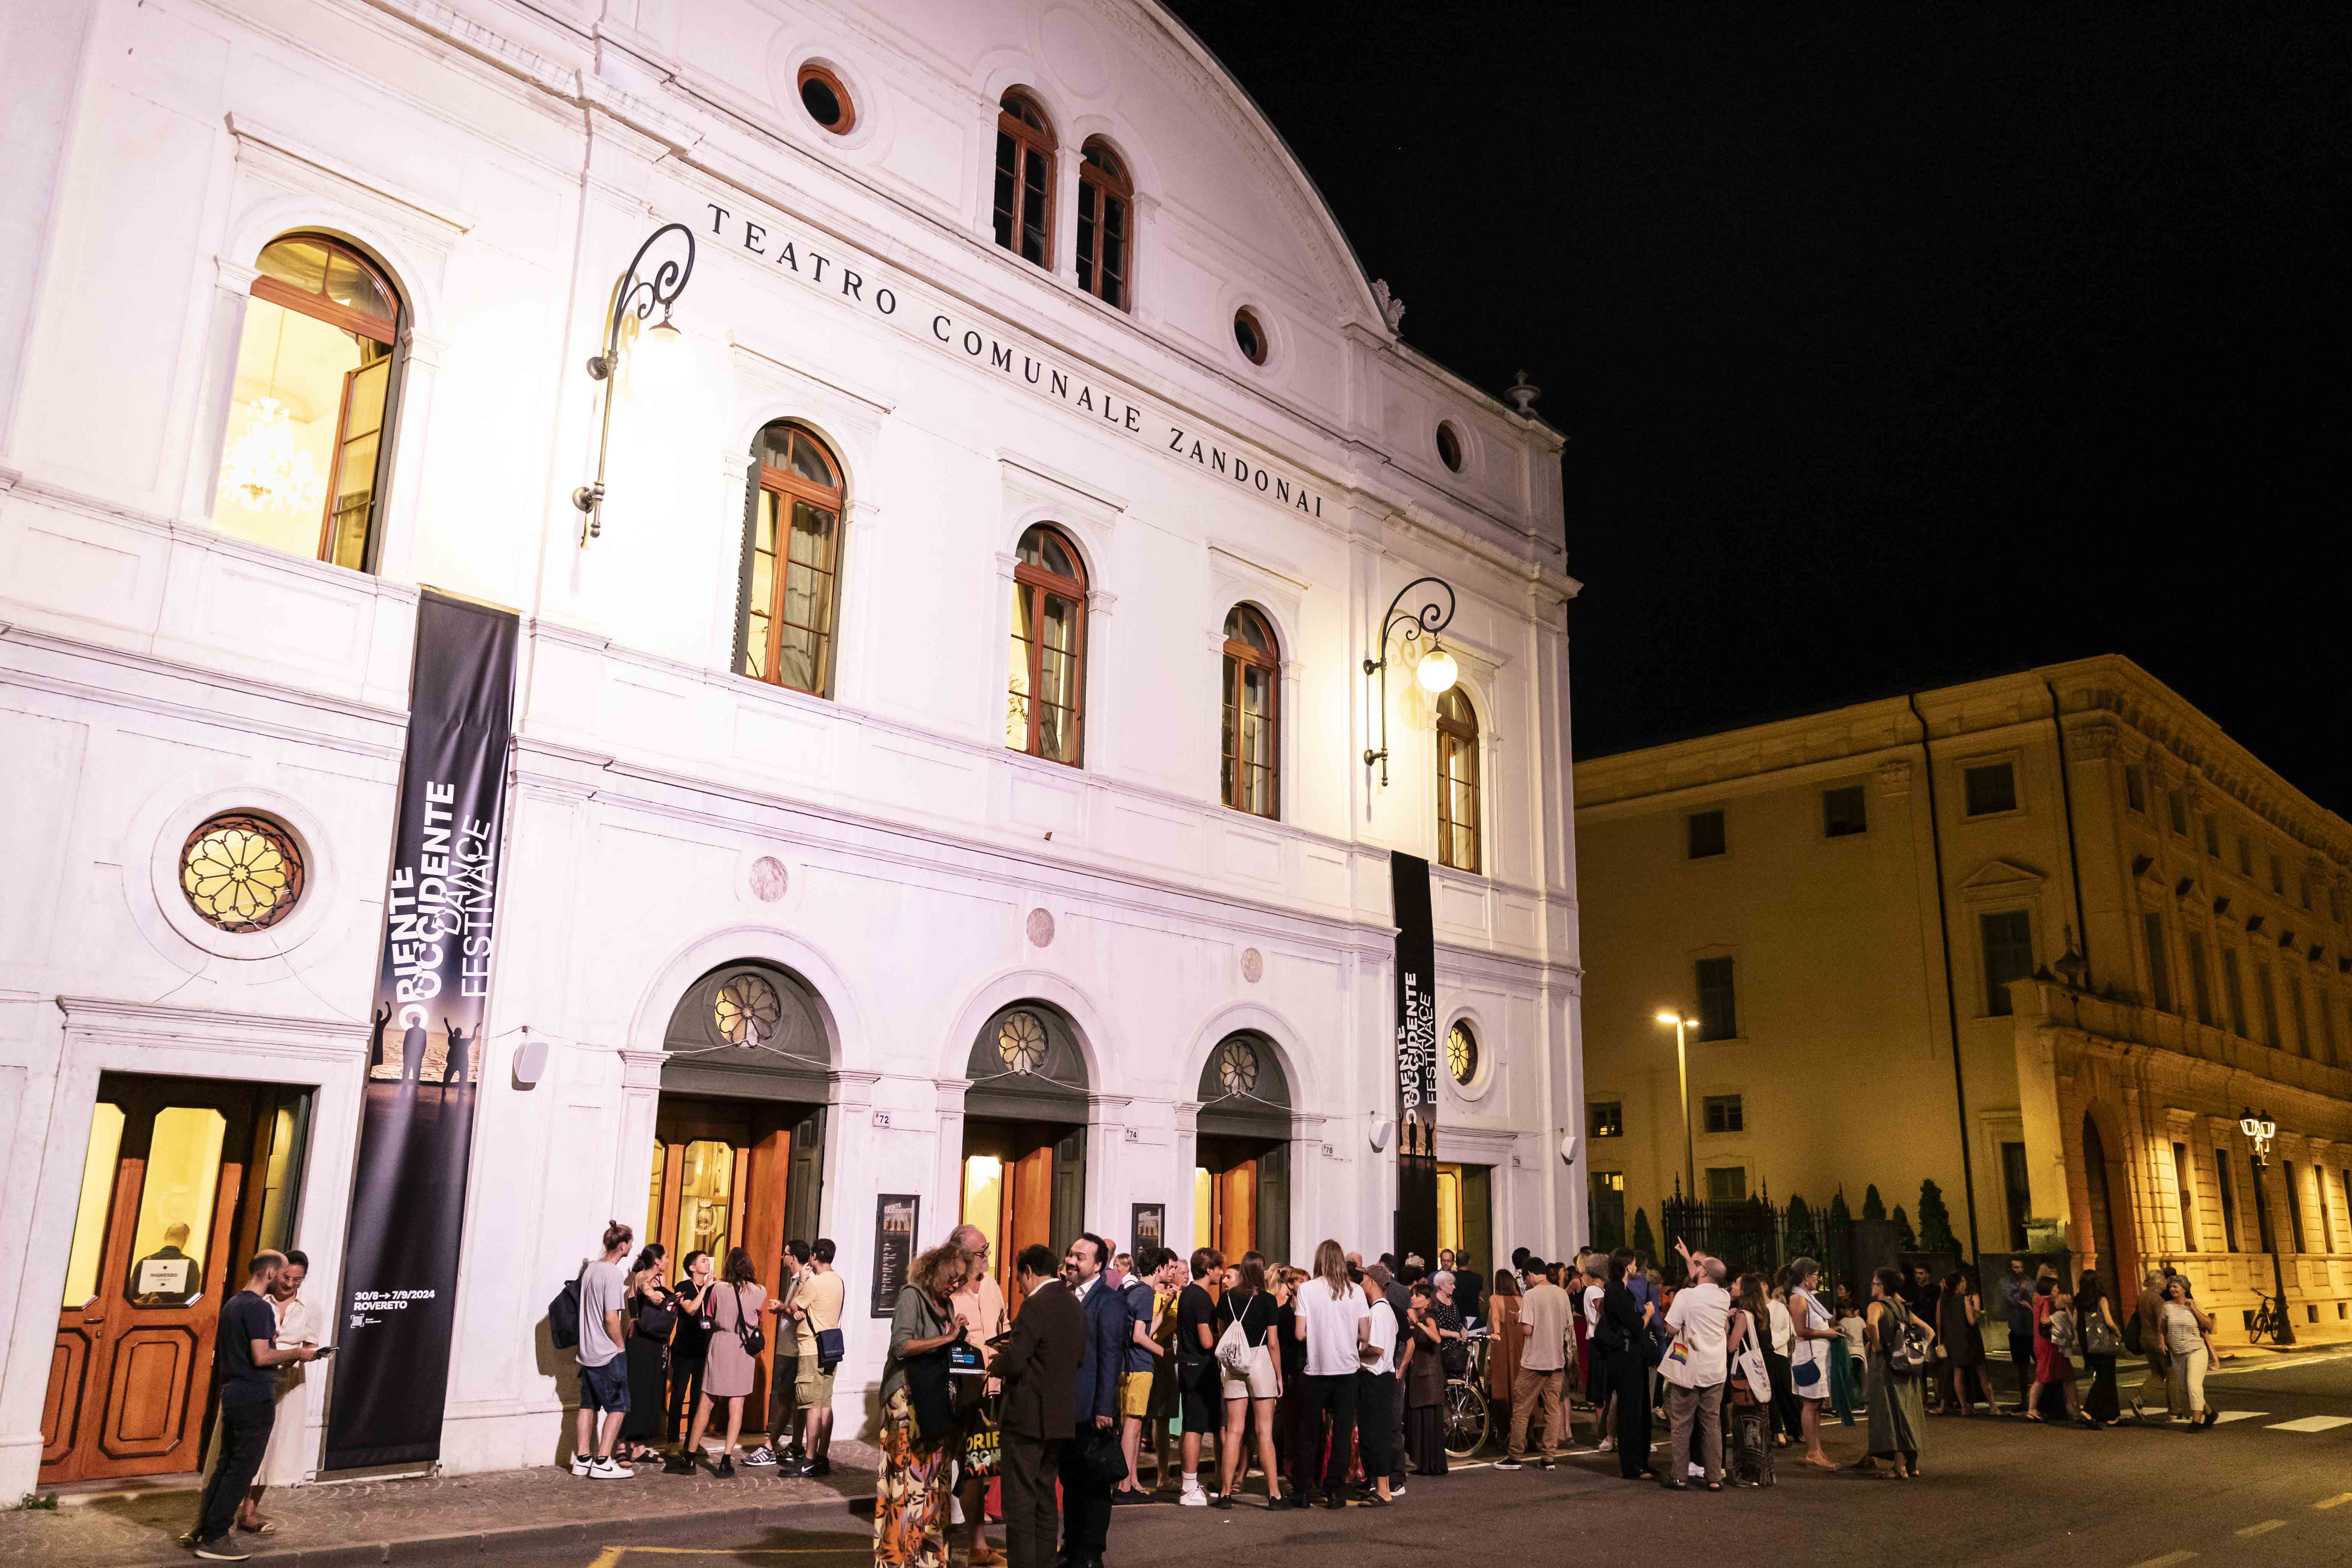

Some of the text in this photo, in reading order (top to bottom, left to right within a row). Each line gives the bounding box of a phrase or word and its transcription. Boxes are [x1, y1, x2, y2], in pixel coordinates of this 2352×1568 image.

[707, 203, 1323, 518] TEATRO COMUNALE ZANDONAI
[413, 781, 455, 999] OCCIDENTE
[431, 814, 491, 935] DANCE
[461, 842, 494, 997] FESTIVAL
[389, 867, 429, 1031] ORIENTE
[1397, 1025, 1417, 1124] ORIENTE
[1405, 972, 1421, 1107] OCCIDENTE
[1414, 992, 1431, 1067] DANCE
[1425, 1005, 1436, 1104] FESTIVAL
[879, 1115, 889, 1124] 72
[354, 1301, 408, 1311] ROVERETO
[355, 1290, 435, 1300] 30/8 7/9/2024
